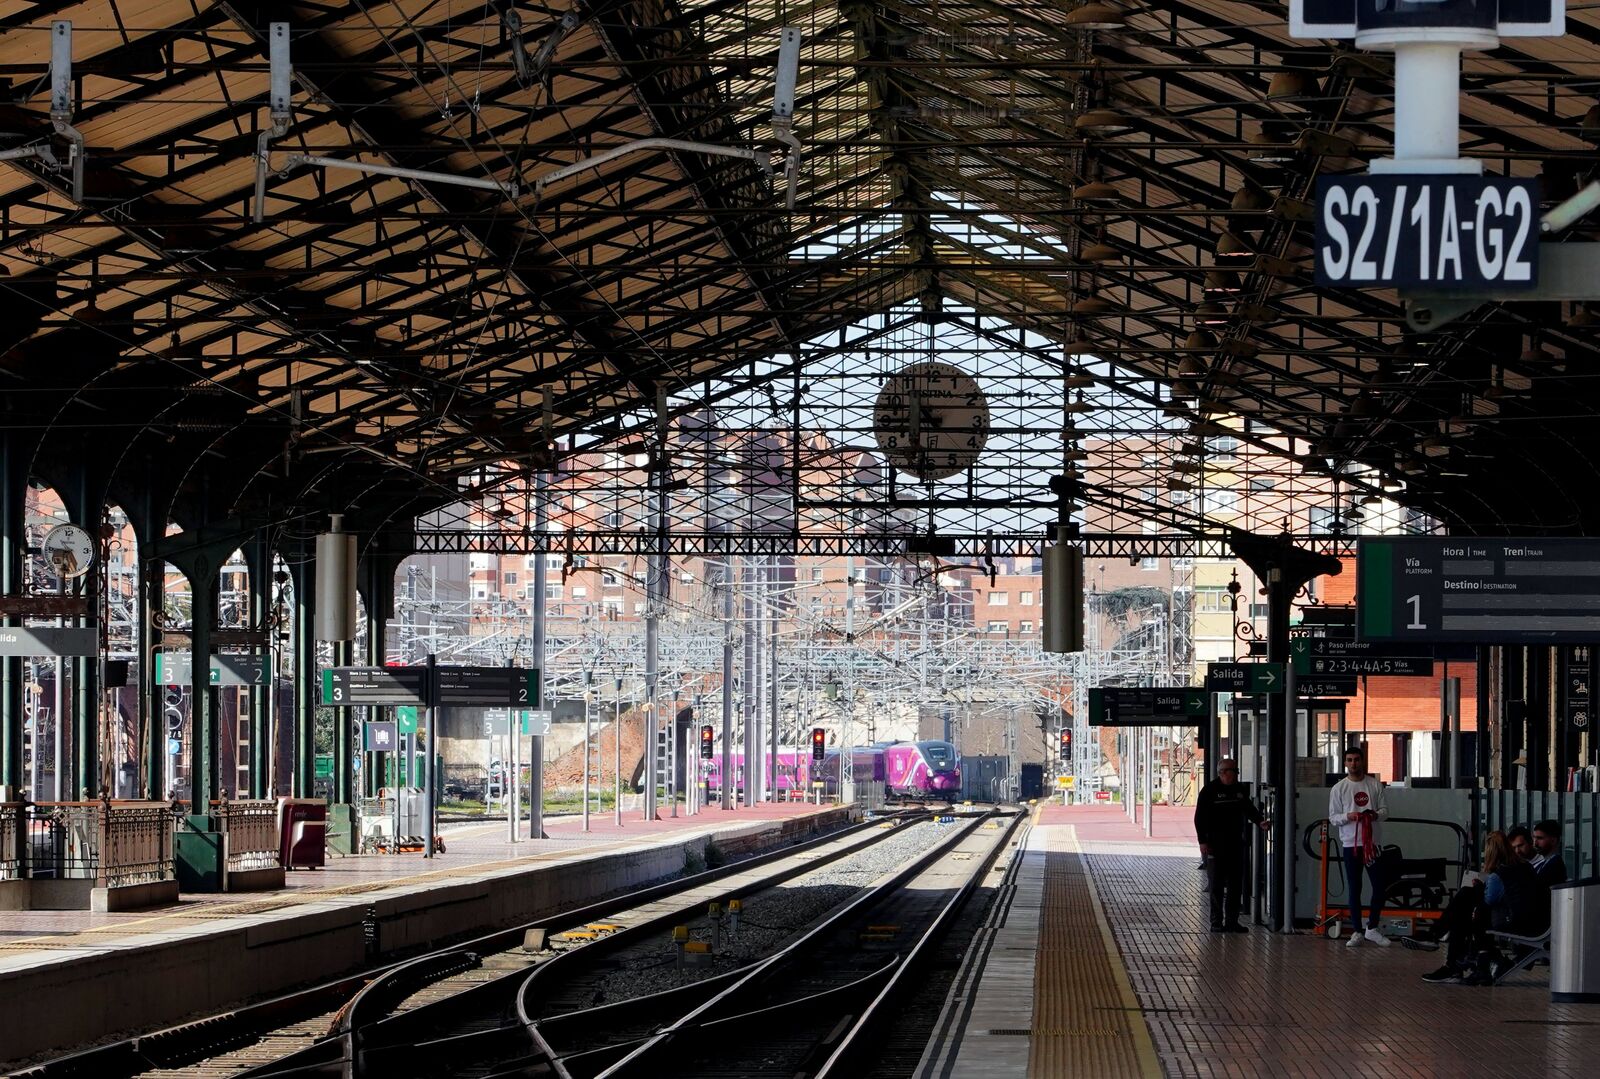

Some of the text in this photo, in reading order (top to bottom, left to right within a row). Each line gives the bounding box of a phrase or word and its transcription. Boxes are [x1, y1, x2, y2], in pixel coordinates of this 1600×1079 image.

[1322, 185, 1531, 280] S2/1A-G2
[972, 416, 982, 428] 3
[887, 436, 897, 448] 8
[967, 436, 977, 449] 4
[948, 454, 957, 466] 5
[1443, 547, 1464, 556] Hora
[1504, 547, 1524, 556] Tren
[1406, 557, 1420, 567] Vía
[1444, 580, 1479, 590] Destino
[1406, 595, 1427, 630] 1
[165, 668, 173, 682] 3
[255, 669, 262, 682] 2
[1213, 669, 1244, 679] Salida
[334, 688, 342, 701] 3
[519, 688, 527, 702] 2
[1157, 697, 1180, 705] Salida
[1105, 708, 1113, 721] 1
[485, 722, 492, 734] 3
[543, 722, 550, 734] 2
